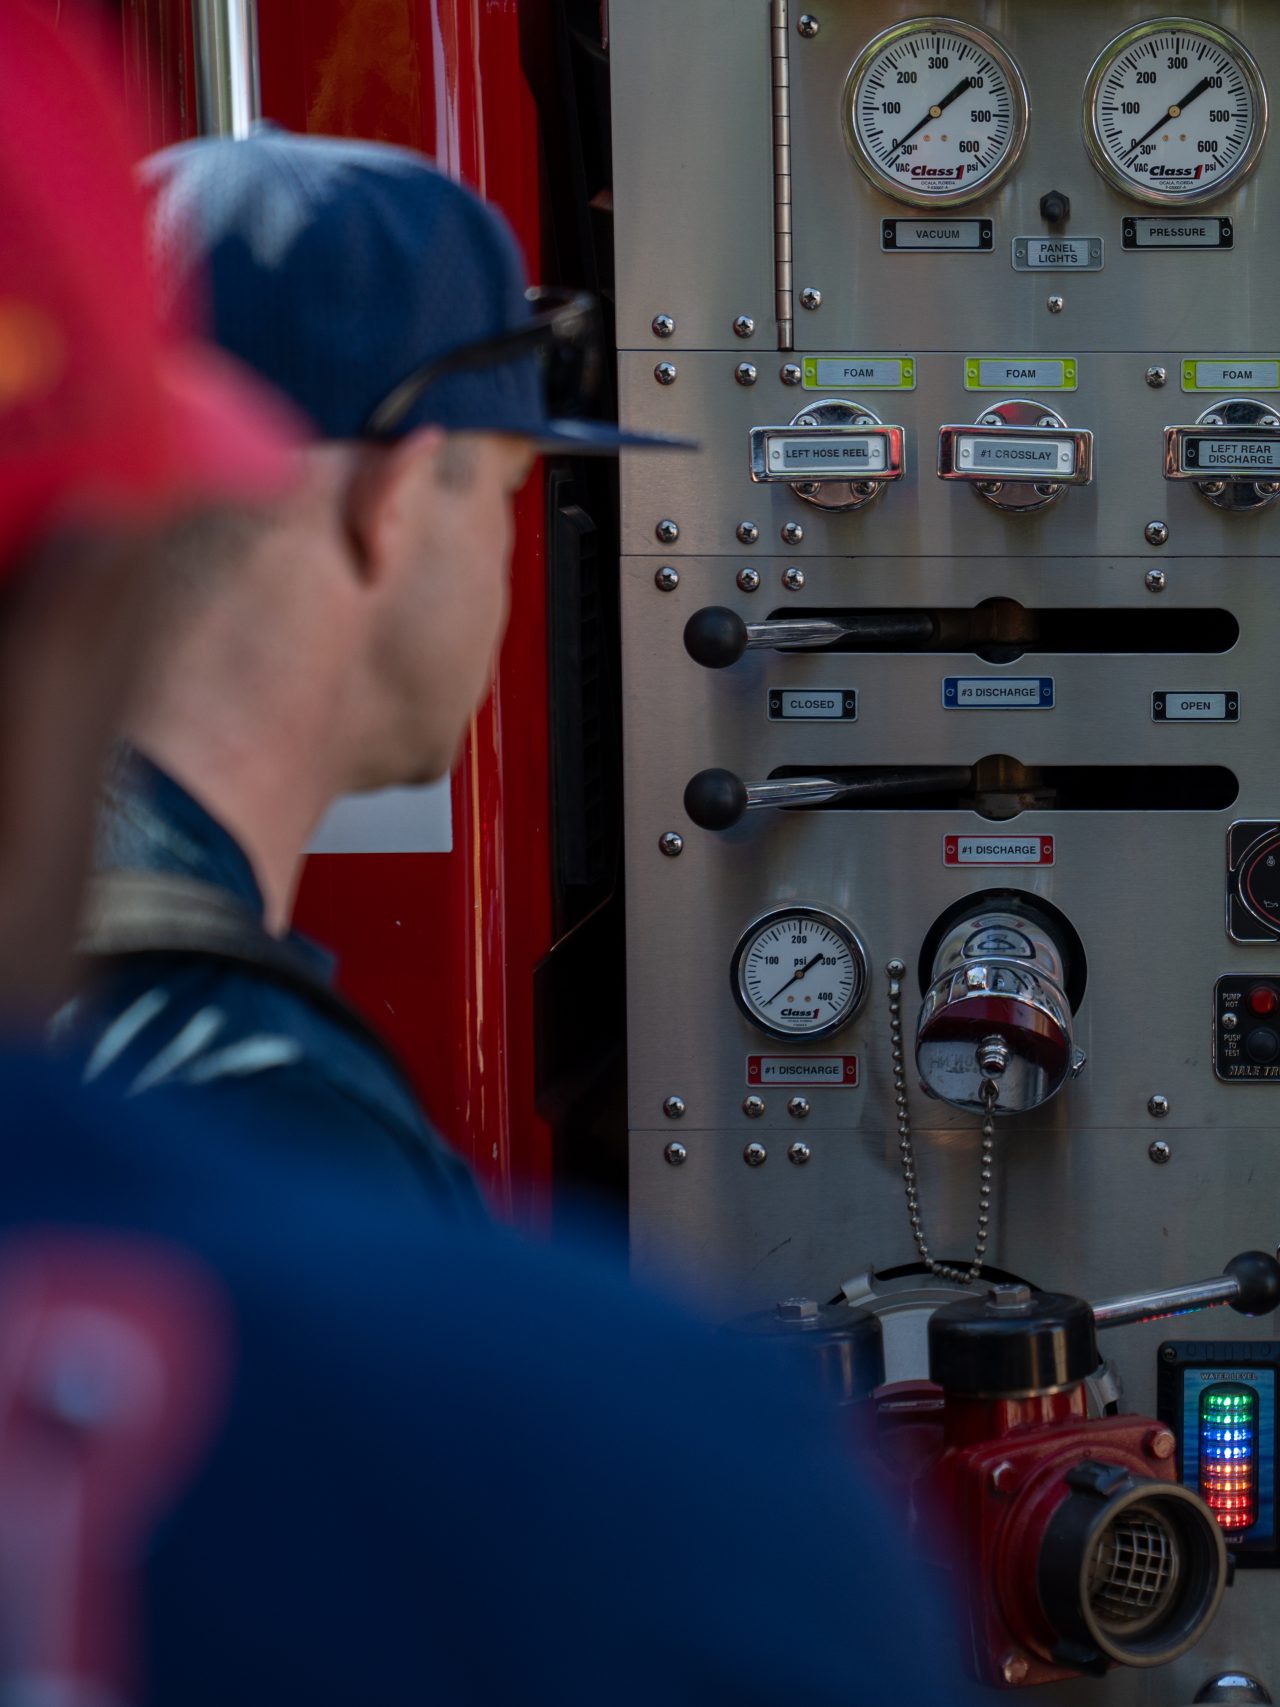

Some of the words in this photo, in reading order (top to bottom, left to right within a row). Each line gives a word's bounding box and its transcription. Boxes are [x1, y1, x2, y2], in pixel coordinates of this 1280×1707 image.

[928, 57, 948, 69] 300
[1167, 57, 1188, 69] 300
[896, 72, 917, 84] 200
[1136, 72, 1157, 84] 200
[882, 102, 900, 114] 100
[1121, 102, 1140, 114] 100
[971, 111, 991, 123] 500
[1209, 110, 1230, 123] 500
[901, 144, 918, 155] 30"
[959, 141, 979, 153] 600
[1140, 144, 1156, 155] 30"
[1197, 141, 1218, 153] 600
[895, 163, 910, 173] VAC
[967, 162, 978, 173] psi
[1134, 163, 1148, 173] VAC
[1205, 162, 1217, 173] psi
[915, 229, 960, 239] VACUUM
[1149, 228, 1206, 237] PRESSURE
[1040, 244, 1076, 253] PANEL
[1038, 254, 1078, 263] LIGHTS
[843, 368, 874, 377] FOAM
[1006, 369, 1036, 378] FOAM
[1222, 370, 1253, 379] FOAM
[786, 449, 809, 459] LEFT
[813, 449, 840, 458] HOSE
[843, 448, 868, 458] REEL
[1211, 444, 1238, 453] LEFT
[1240, 445, 1271, 454] REAR
[980, 449, 992, 459] #1
[995, 449, 1052, 461] CROSSLAY
[1208, 454, 1273, 464] DISCHARGE
[961, 687, 974, 697] #3
[975, 687, 1036, 697] DISCHARGE
[790, 699, 835, 710] CLOSED
[1180, 701, 1211, 711] OPEN
[961, 845, 973, 855] #1
[975, 845, 1037, 855] DISCHARGE
[791, 935, 807, 944] 200
[764, 956, 779, 966] 100
[793, 956, 807, 968] psi
[820, 957, 837, 966] 300
[817, 992, 833, 1002] 400
[1222, 993, 1242, 1001] PUMP
[1224, 1049, 1240, 1057] TEST
[764, 1066, 775, 1075] #1
[779, 1066, 840, 1075] DISCHARGE
[1200, 1373, 1230, 1381] WATER
[1230, 1373, 1257, 1381] LEVEL
